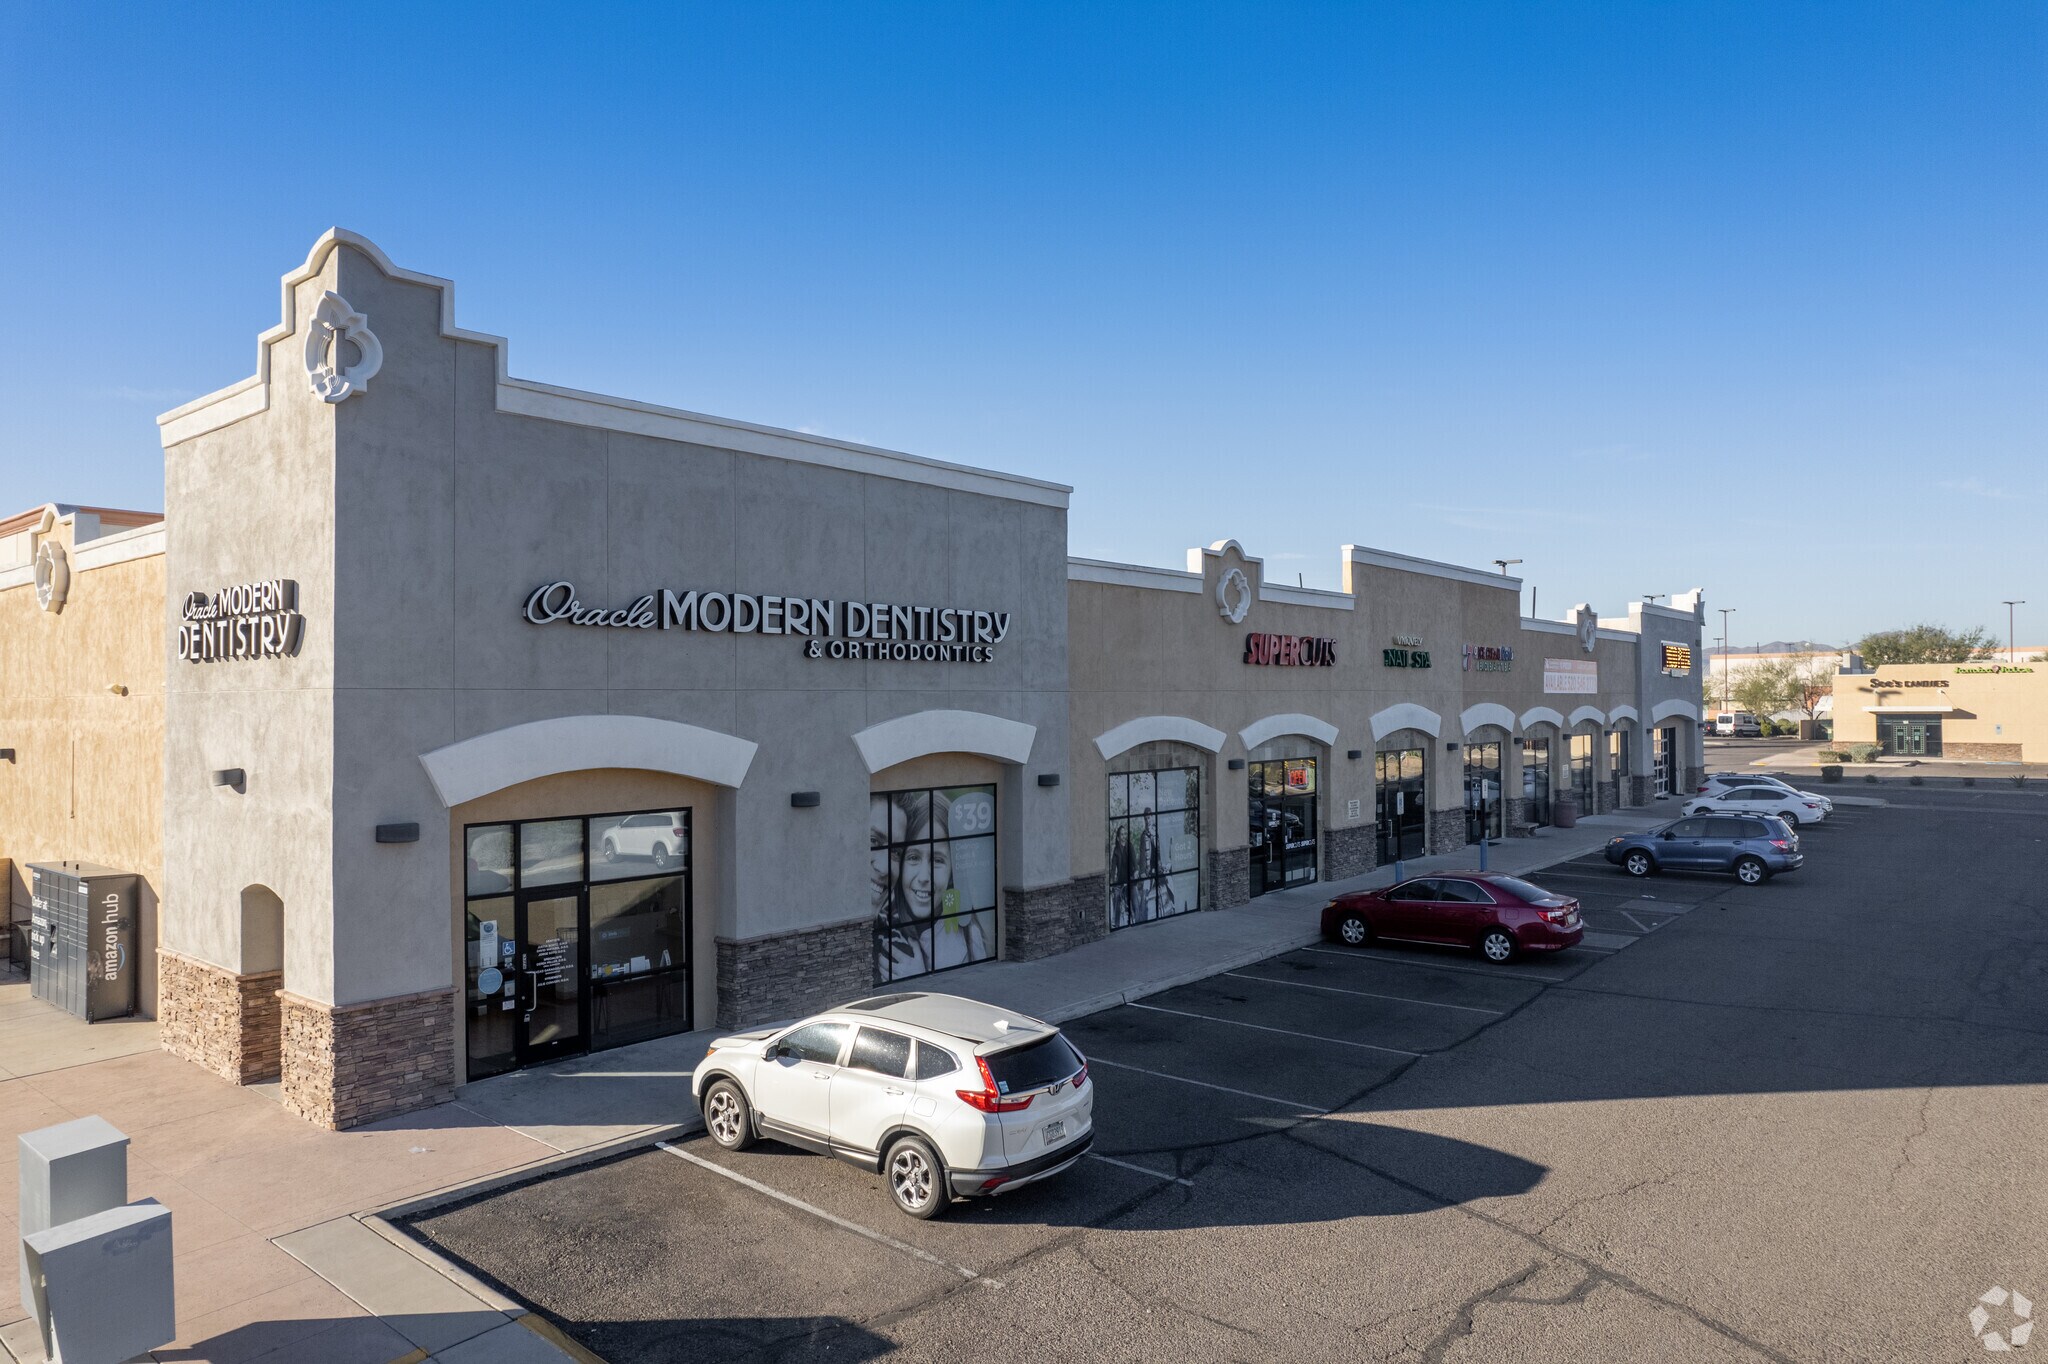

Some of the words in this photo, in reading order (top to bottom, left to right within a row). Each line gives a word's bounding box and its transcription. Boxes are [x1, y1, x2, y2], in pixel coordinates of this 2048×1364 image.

[182, 591, 218, 620] Oracle
[220, 579, 283, 617] MODERN
[524, 580, 657, 628] Oracle
[661, 588, 834, 637] MODERN
[845, 600, 1011, 644] DENTISTRY
[178, 613, 290, 660] DENTISTRY
[807, 640, 822, 659] &
[828, 640, 994, 662] ORTHODONTICS
[1247, 633, 1337, 666] SUPERCUTS
[1415, 651, 1432, 668] SPA
[1869, 678, 1903, 688] See's
[1904, 680, 1949, 688] CANDIES
[955, 801, 992, 832] $39
[101, 893, 119, 924] hub
[105, 927, 118, 981] amazon
